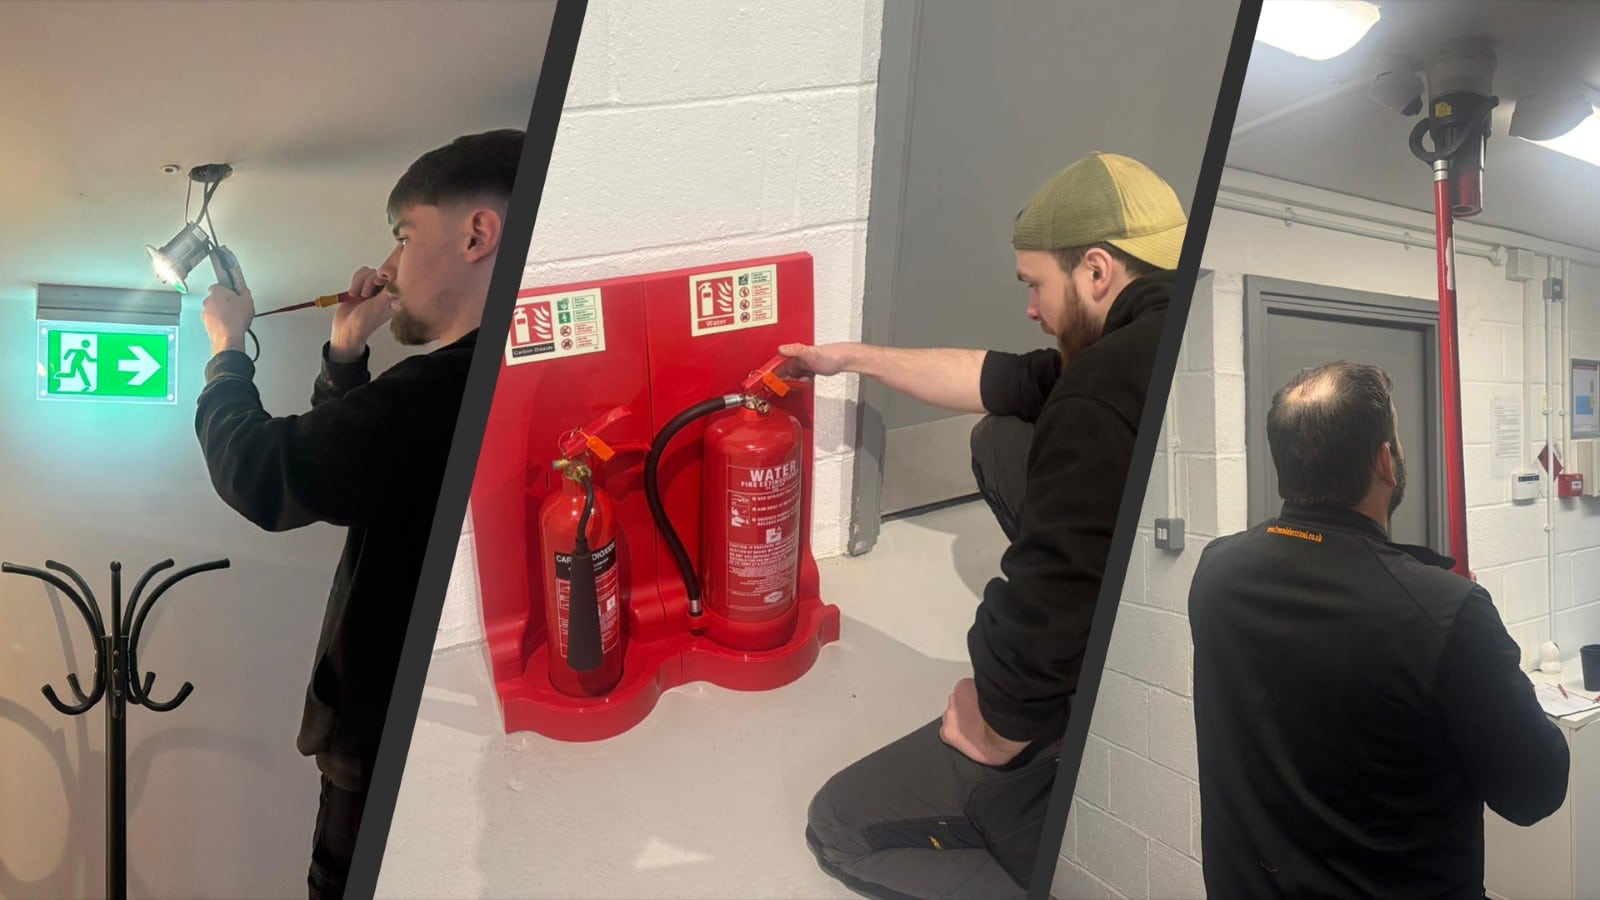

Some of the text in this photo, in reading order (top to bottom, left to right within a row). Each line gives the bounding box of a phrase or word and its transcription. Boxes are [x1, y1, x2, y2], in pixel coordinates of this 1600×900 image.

[706, 319, 727, 327] Water
[513, 344, 554, 356] Carbon Dioxide
[750, 460, 799, 482] WATER
